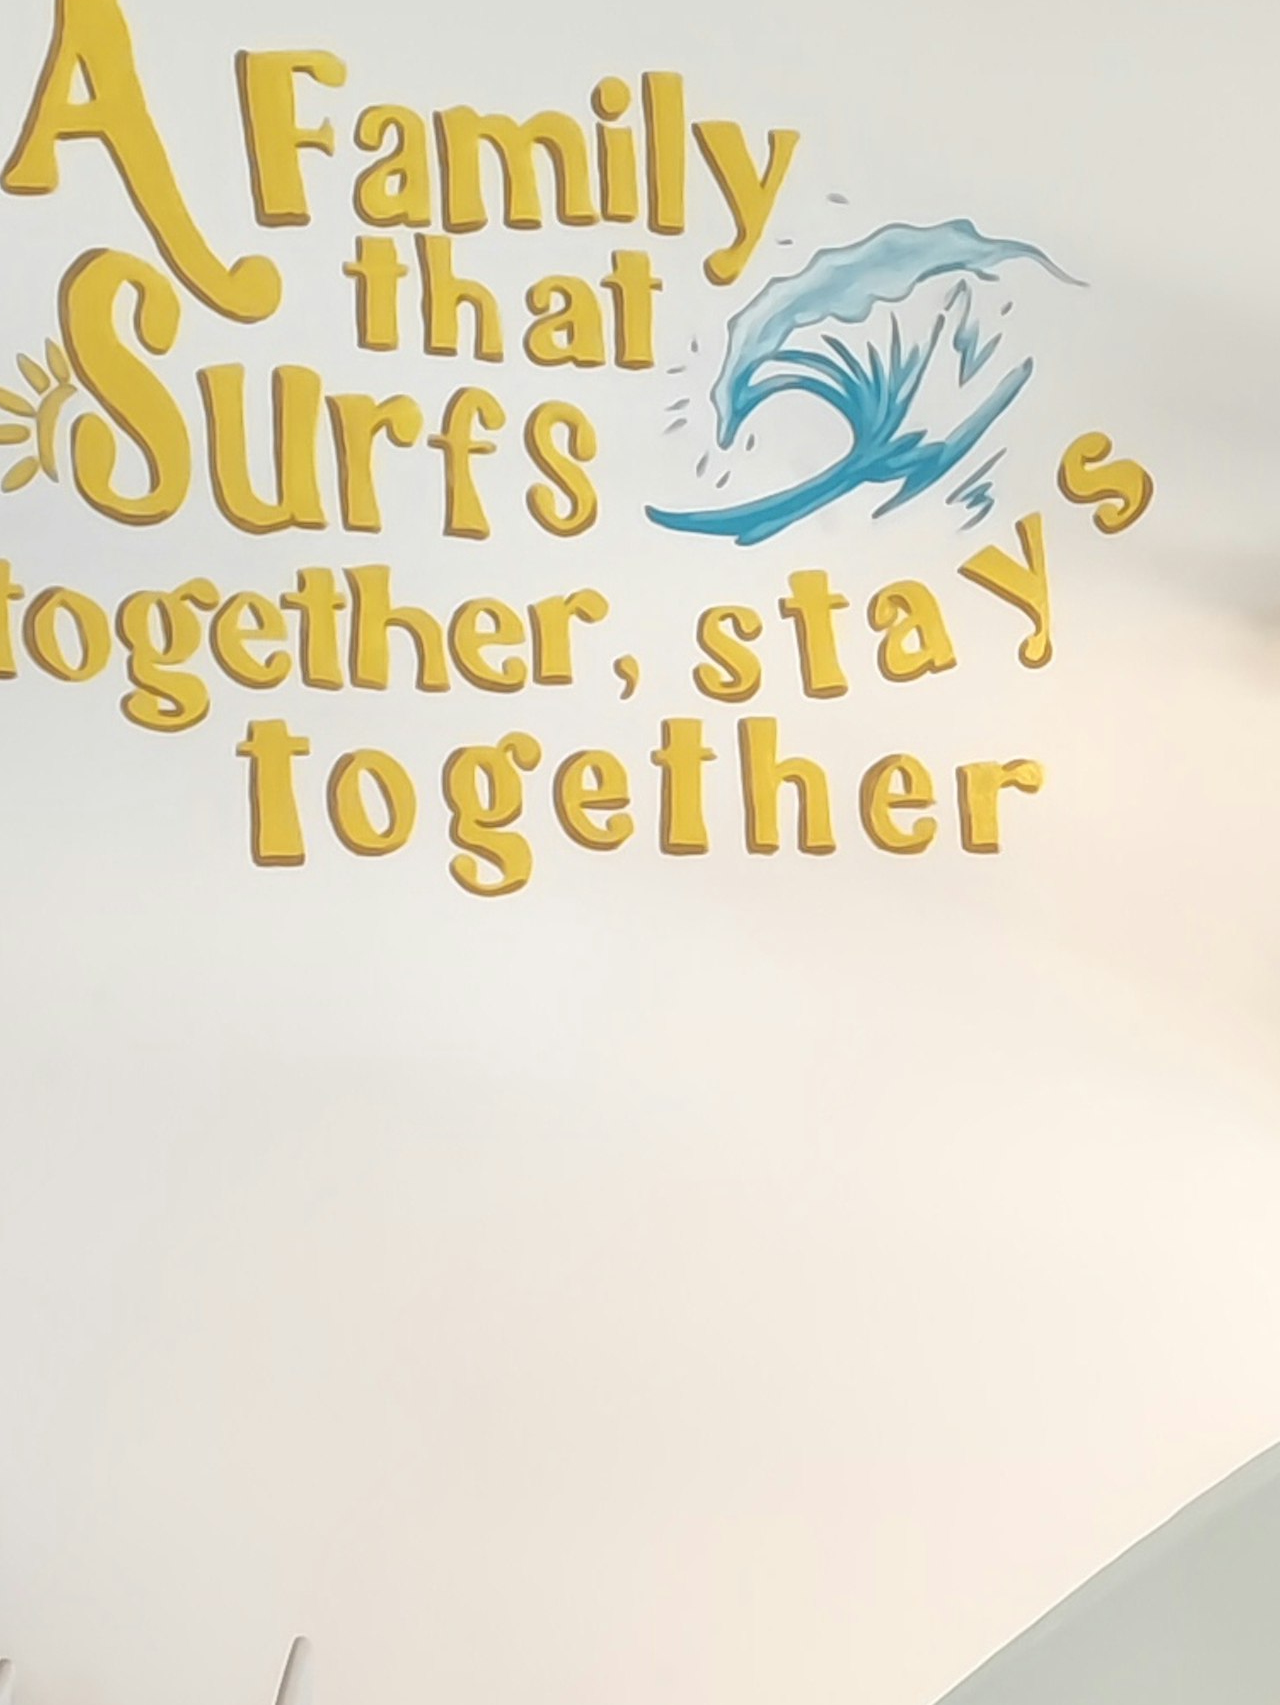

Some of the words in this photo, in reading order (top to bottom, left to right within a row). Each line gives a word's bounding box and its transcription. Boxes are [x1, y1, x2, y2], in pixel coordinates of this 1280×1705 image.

[235, 49, 800, 285] Family
[58, 247, 599, 540] Surfs
[343, 233, 662, 371] that
[692, 430, 1155, 700] stays
[235, 717, 1046, 898] together
